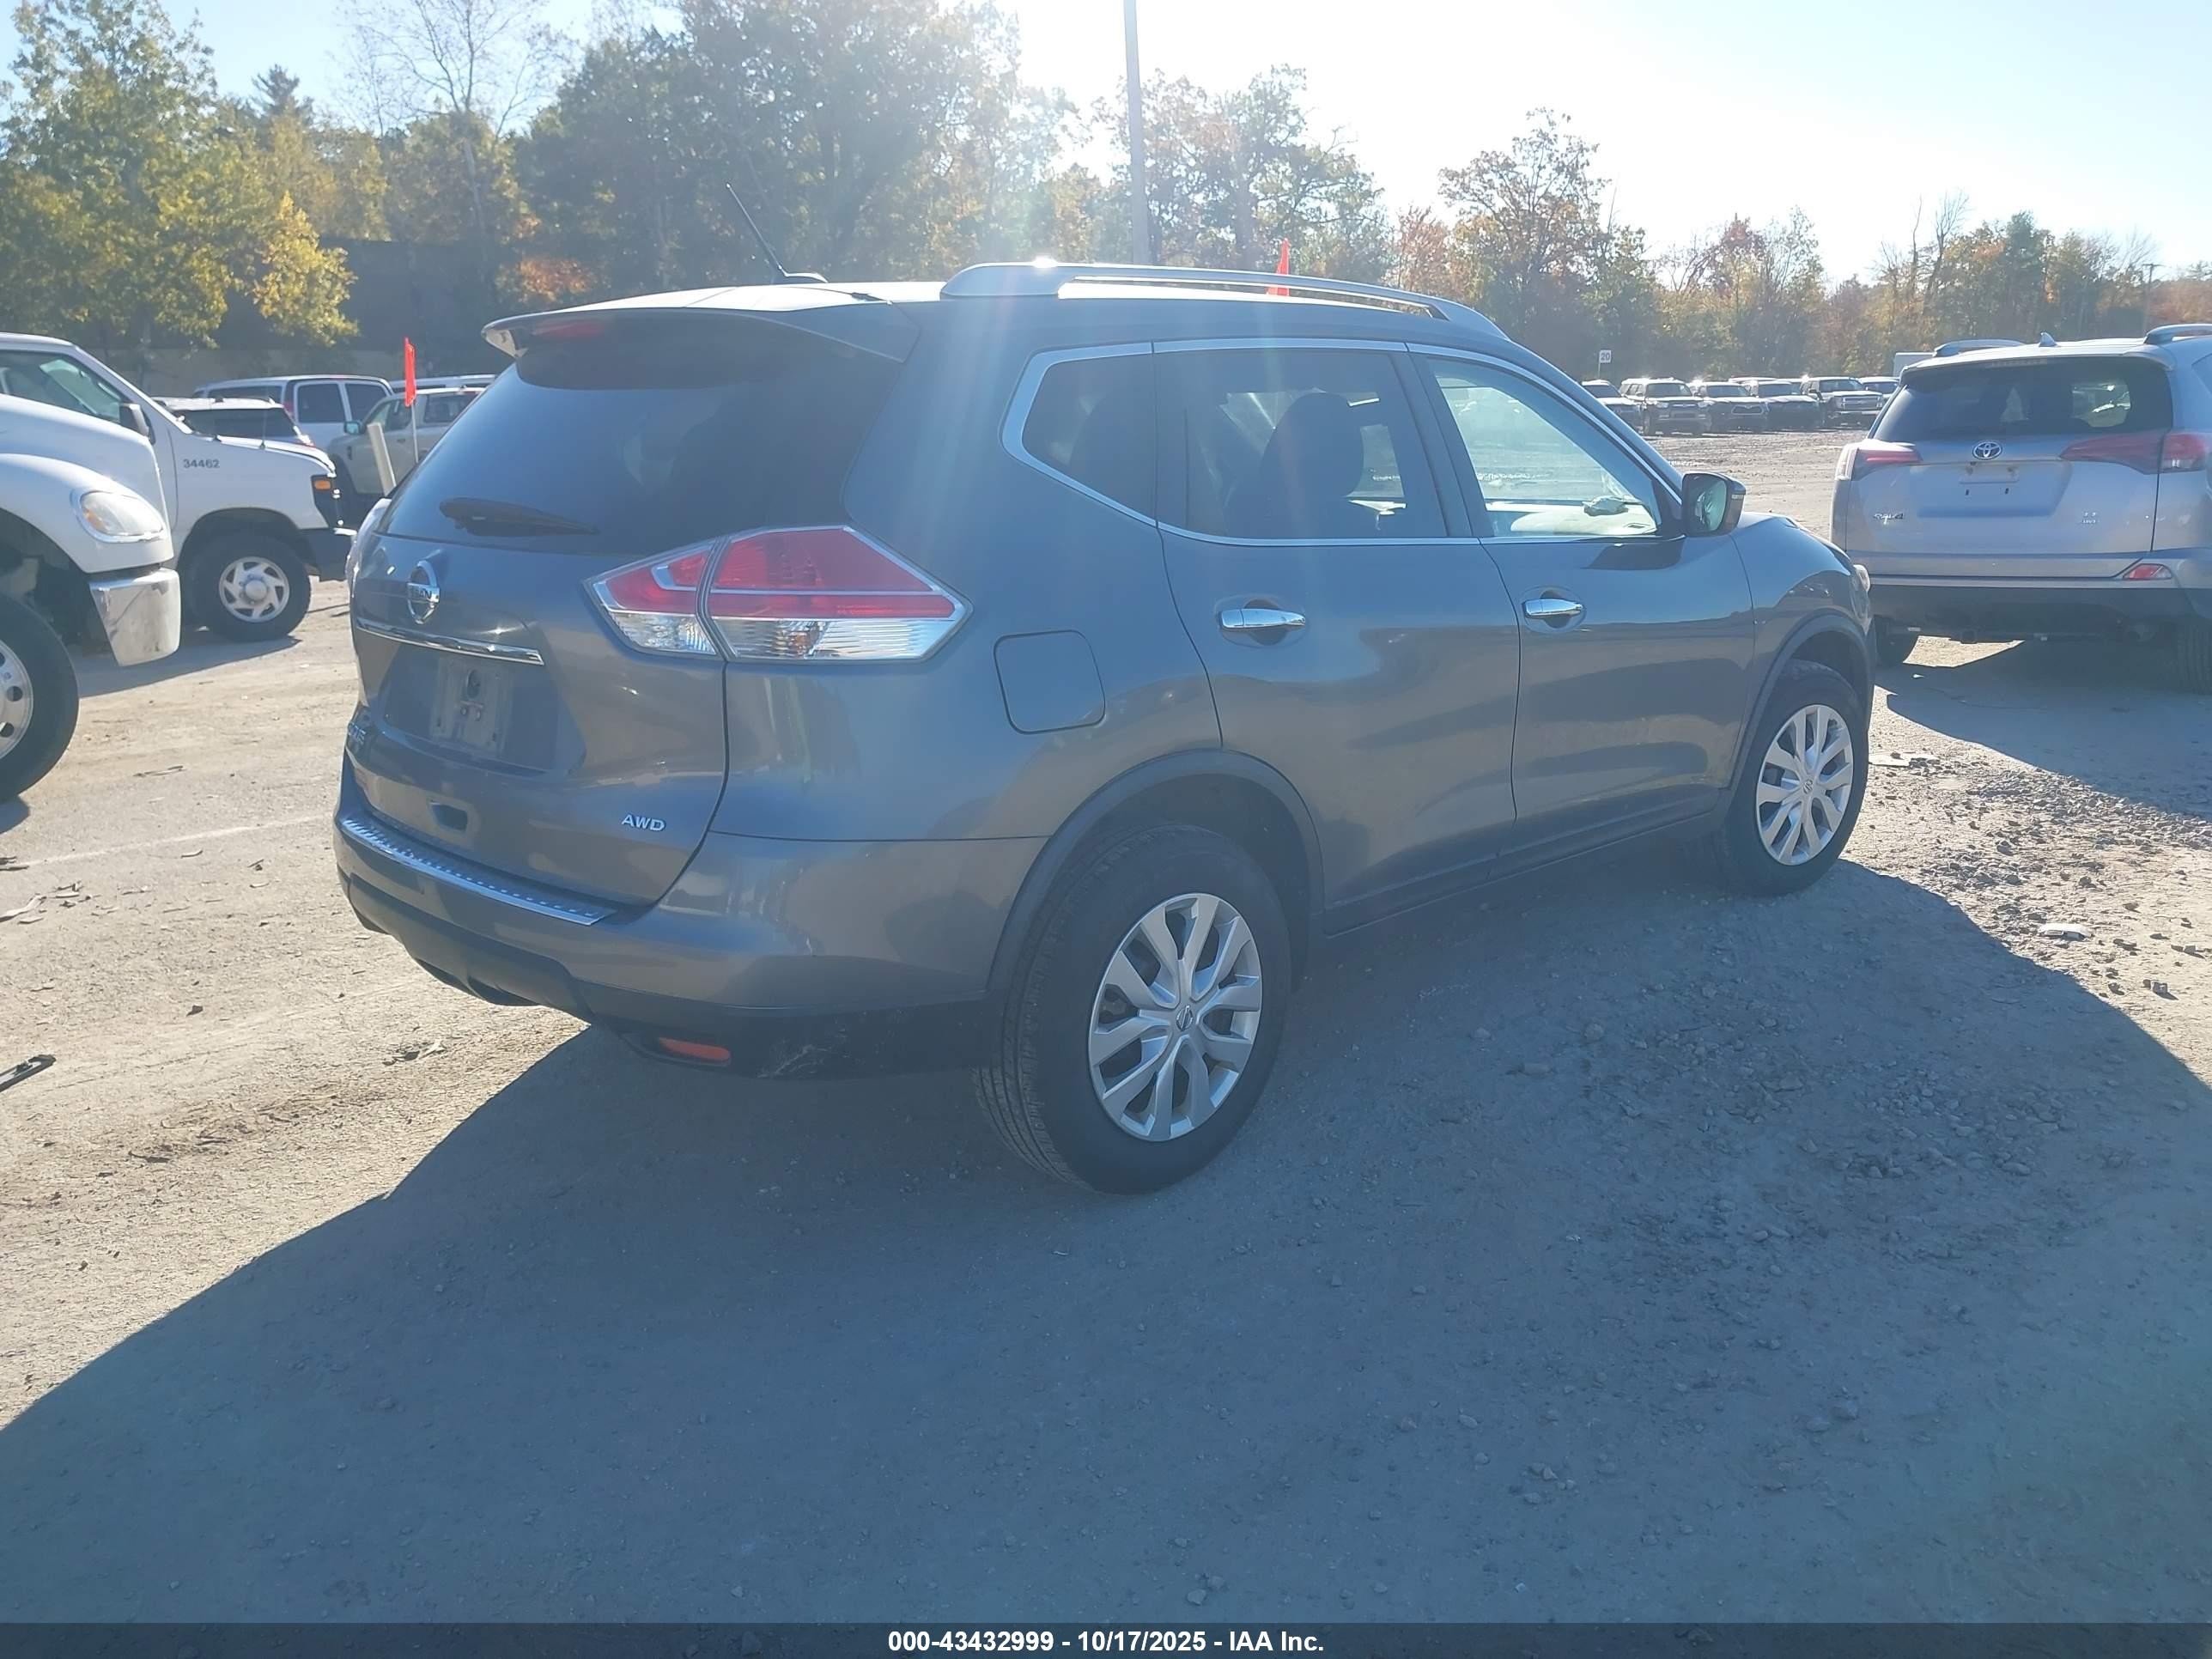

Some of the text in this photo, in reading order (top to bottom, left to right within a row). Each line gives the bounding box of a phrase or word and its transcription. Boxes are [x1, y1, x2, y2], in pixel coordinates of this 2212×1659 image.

[1601, 352, 1611, 362] 20
[183, 459, 221, 469] 34462
[621, 814, 665, 831] AWD
